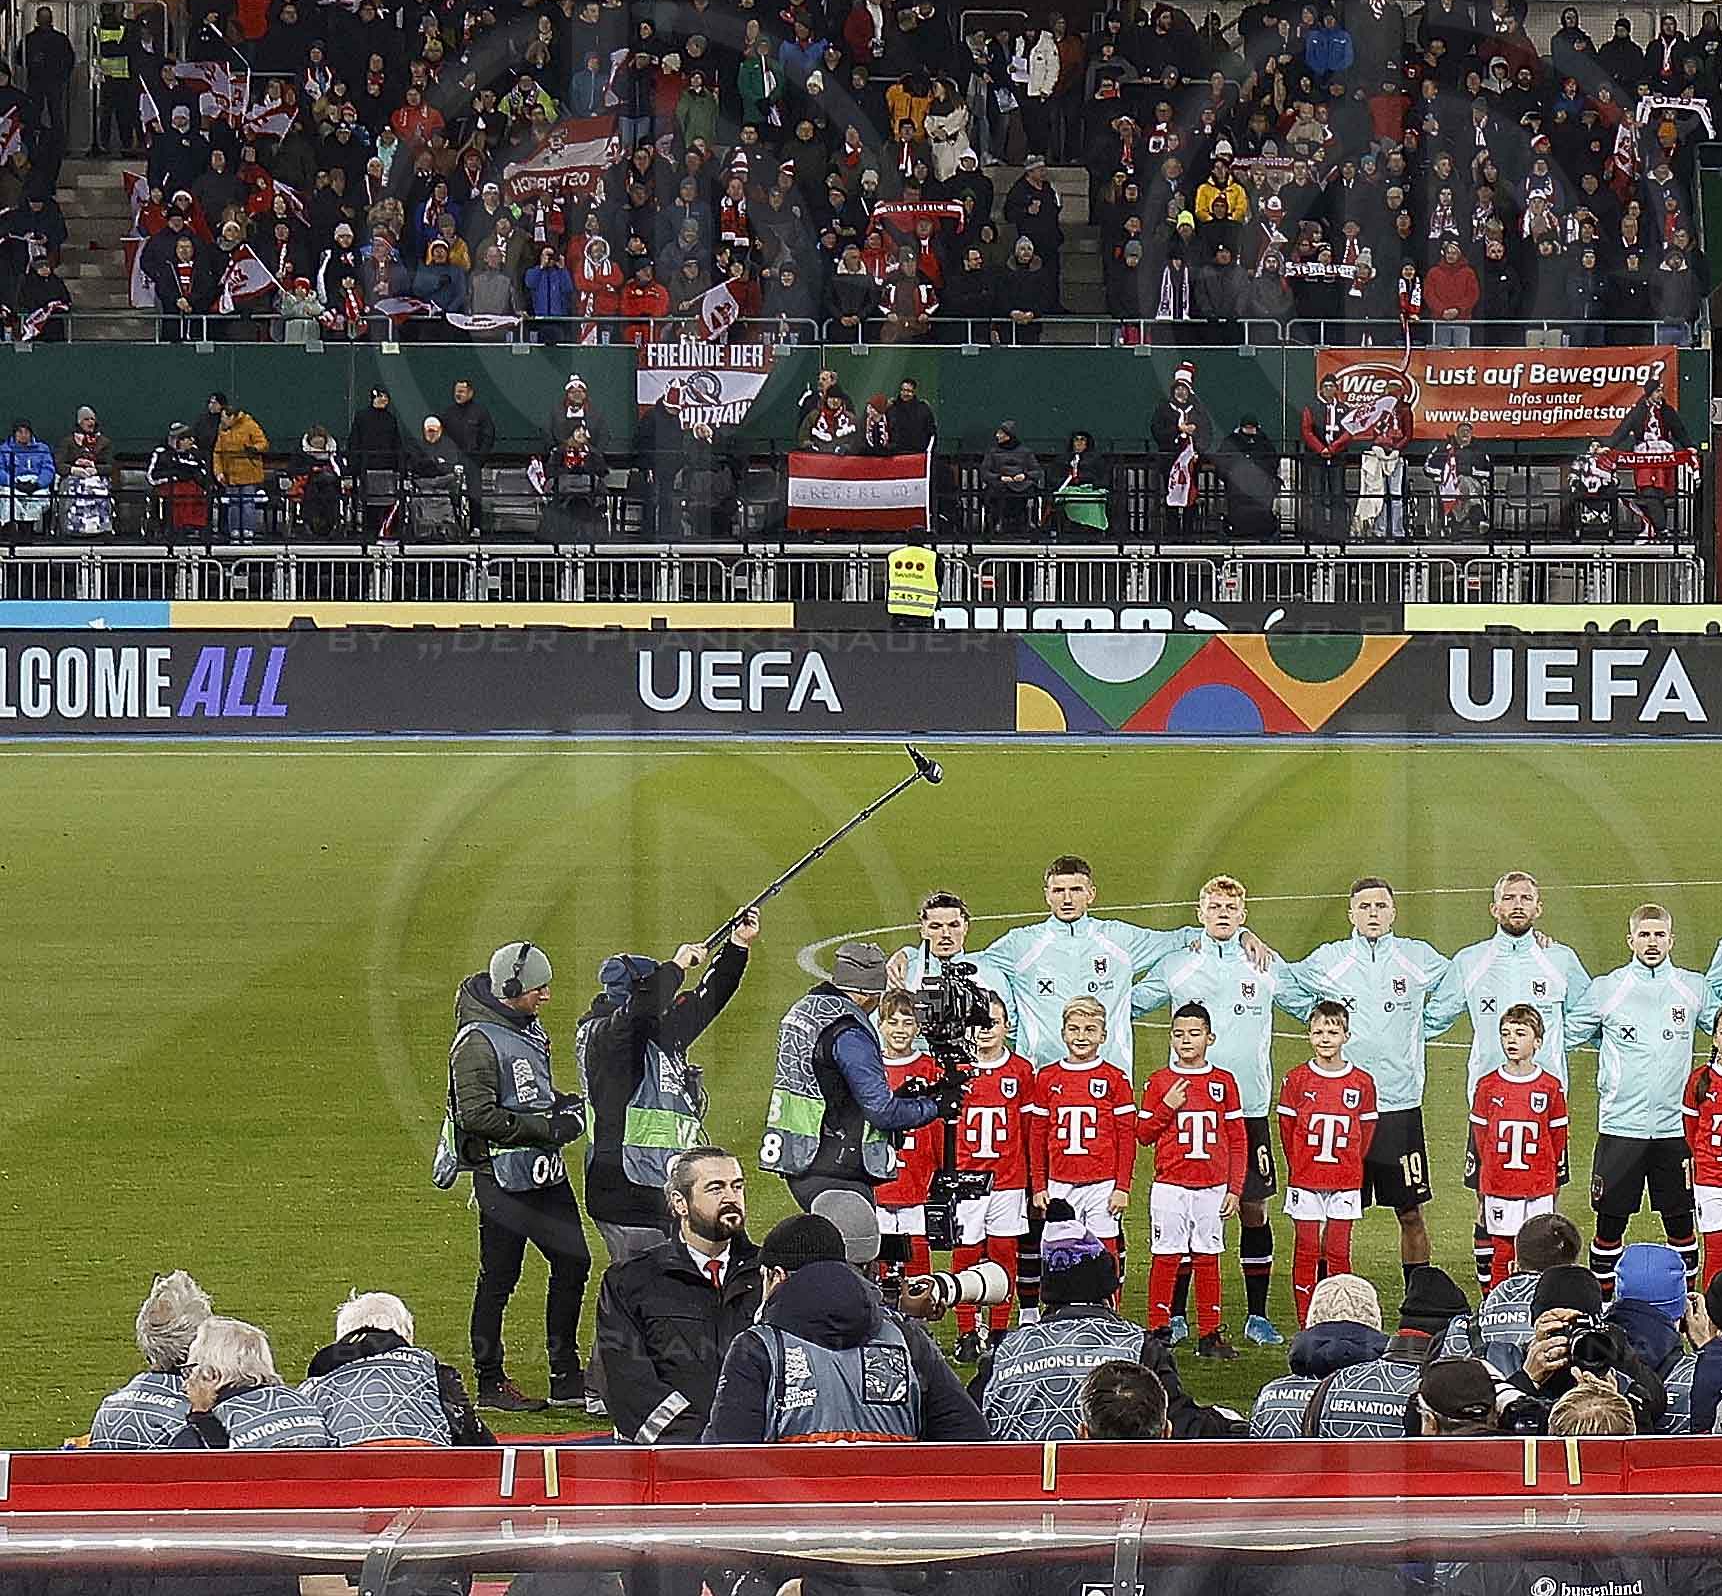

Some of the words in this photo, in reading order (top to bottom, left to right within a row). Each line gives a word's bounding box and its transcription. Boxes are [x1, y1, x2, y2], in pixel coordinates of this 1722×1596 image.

[731, 343, 764, 367] DER
[1425, 363, 1480, 385] Lust
[1484, 361, 1524, 390] auf
[1530, 361, 1665, 389] Bewegung?
[1509, 390, 1542, 405] Infos
[1547, 392, 1583, 405] unter
[178, 646, 289, 718] ALL
[637, 649, 843, 713] UEFA
[1447, 648, 1708, 722] UEFA
[1399, 1152, 1423, 1187] 19
[1024, 1358, 1073, 1374] NATIONS
